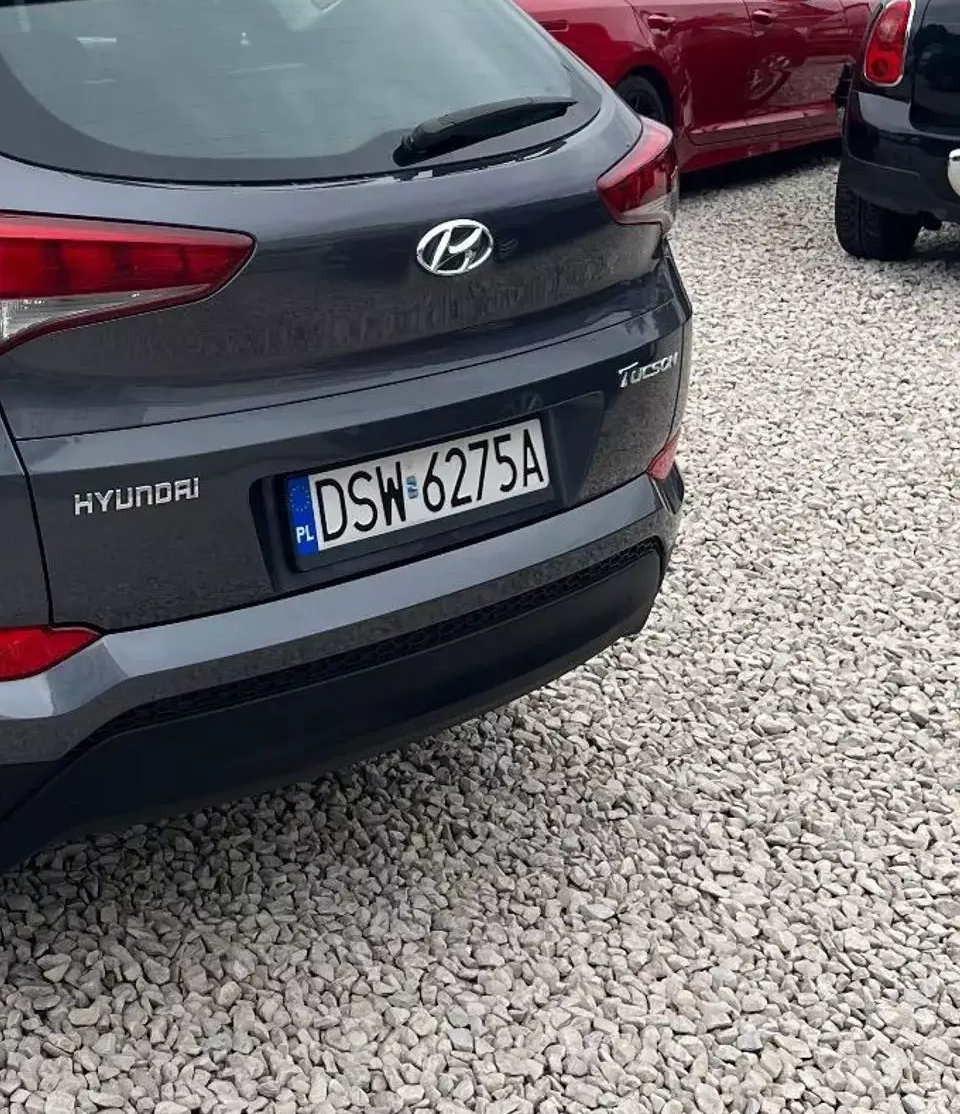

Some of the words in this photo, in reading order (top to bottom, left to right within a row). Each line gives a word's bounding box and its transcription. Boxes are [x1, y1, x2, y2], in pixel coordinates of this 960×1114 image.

[74, 477, 199, 515] HYUNDAI
[315, 461, 407, 542] DSW
[422, 428, 544, 513] 6275A
[296, 524, 315, 544] PL
